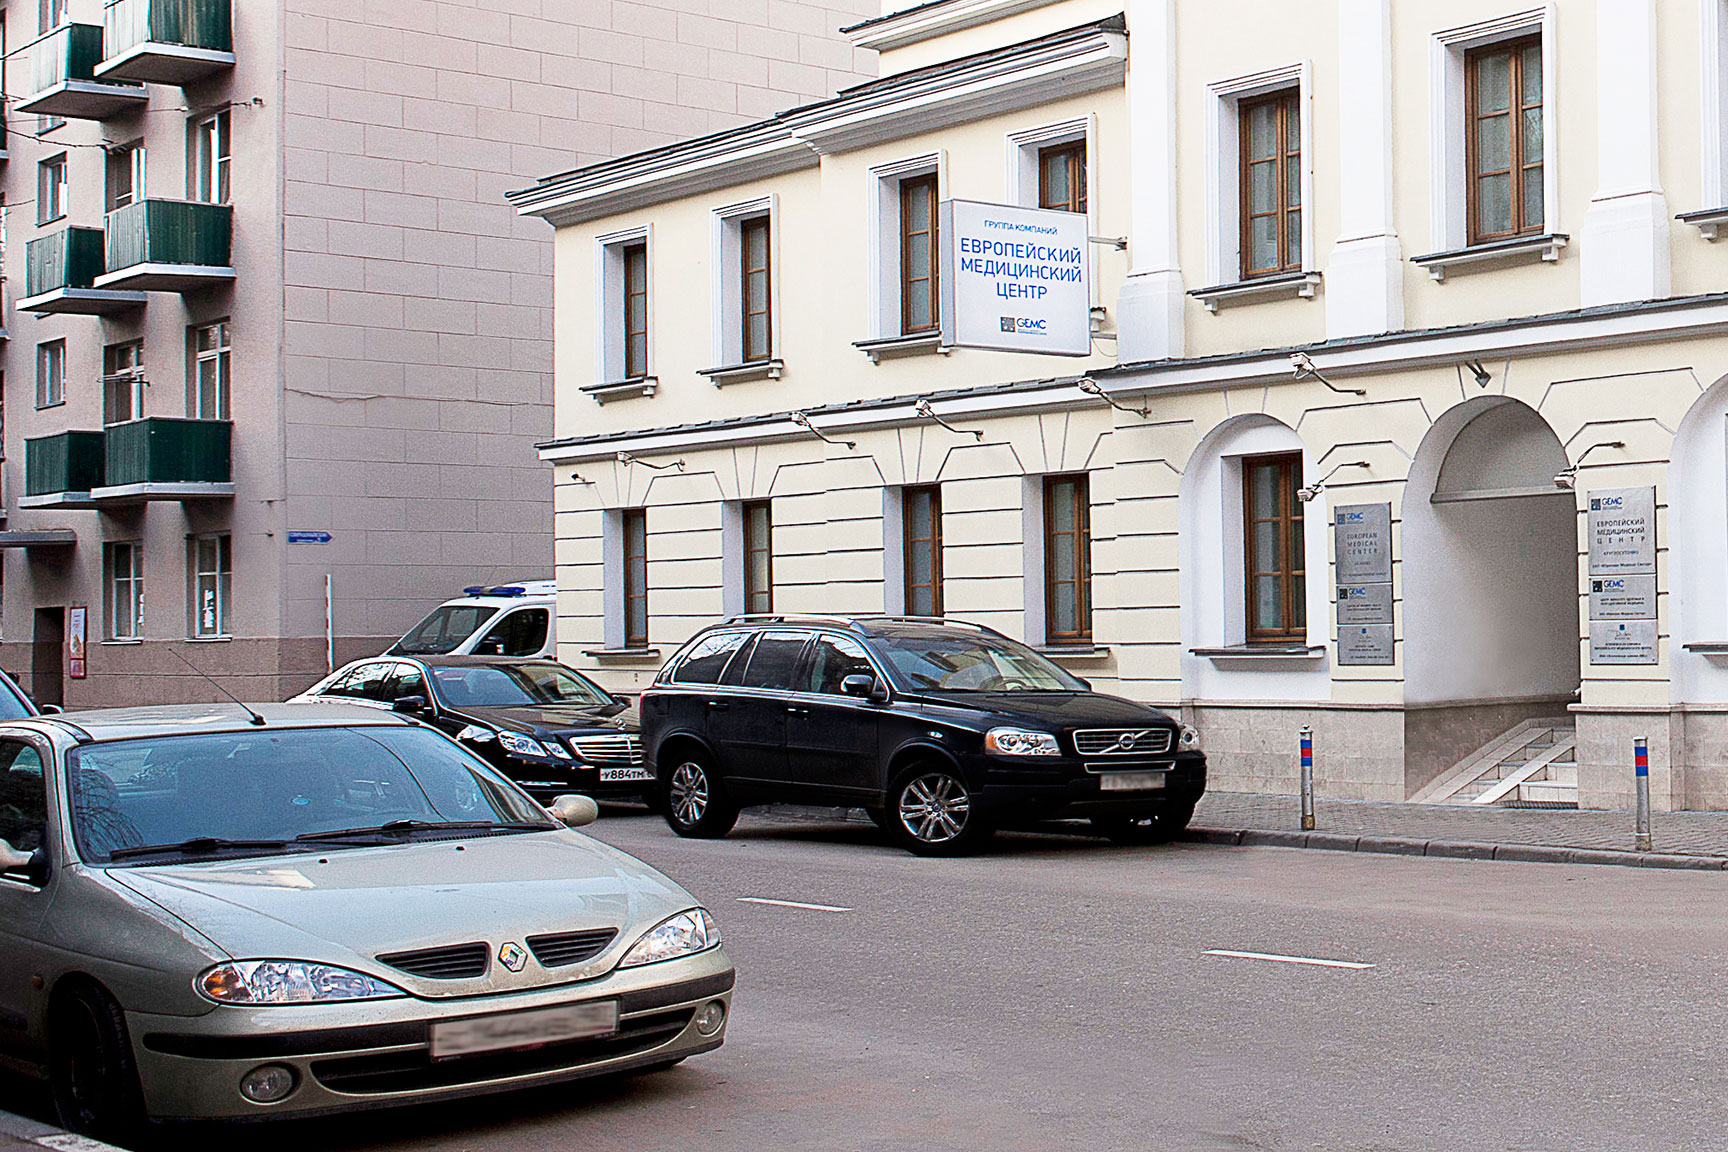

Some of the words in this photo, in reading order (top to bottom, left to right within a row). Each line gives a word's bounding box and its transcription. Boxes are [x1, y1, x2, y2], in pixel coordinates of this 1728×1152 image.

[984, 220, 1014, 231] ГРУППА
[1015, 224, 1058, 235] КОМПАНИЙ
[961, 238, 1081, 264] ЕВРОПЕЙСКИЙ
[961, 257, 1082, 283] МЕДИЦИНСКИЙ
[996, 282, 1048, 299] ЦЕНТР
[1016, 317, 1047, 330] GEMC
[1602, 496, 1623, 506] GEMC
[1596, 517, 1645, 528] ЕВРОПЕЙСКИЙ
[1596, 526, 1645, 536] МЕДИЦИНСКИЙ
[1603, 579, 1625, 588] GEMC
